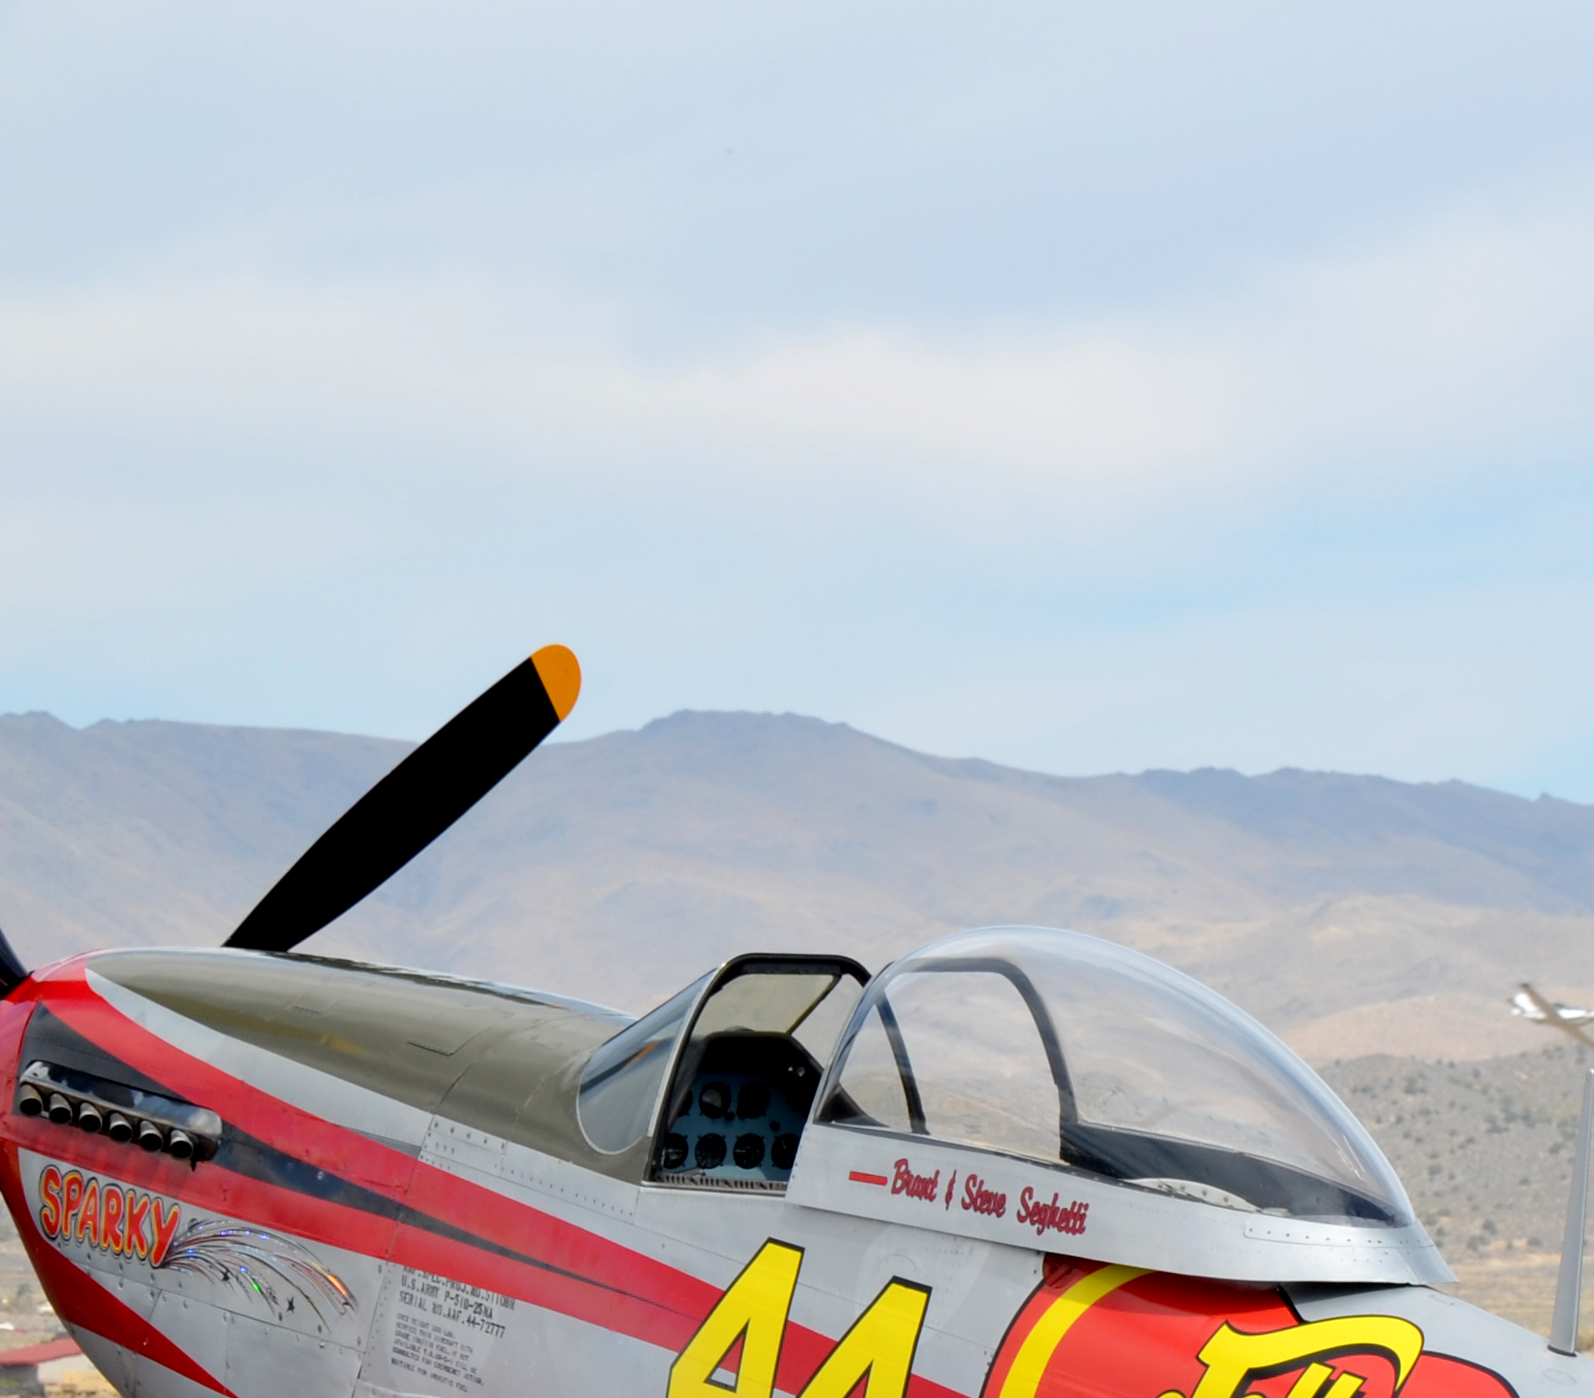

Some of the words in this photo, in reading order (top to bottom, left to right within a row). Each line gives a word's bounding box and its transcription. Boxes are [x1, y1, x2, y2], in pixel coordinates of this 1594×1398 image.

[39, 1164, 182, 1269] SPARKY
[961, 1173, 1007, 1219] Steve
[1016, 1186, 1090, 1236] Seghetti
[399, 1290, 427, 1311] SERIAL
